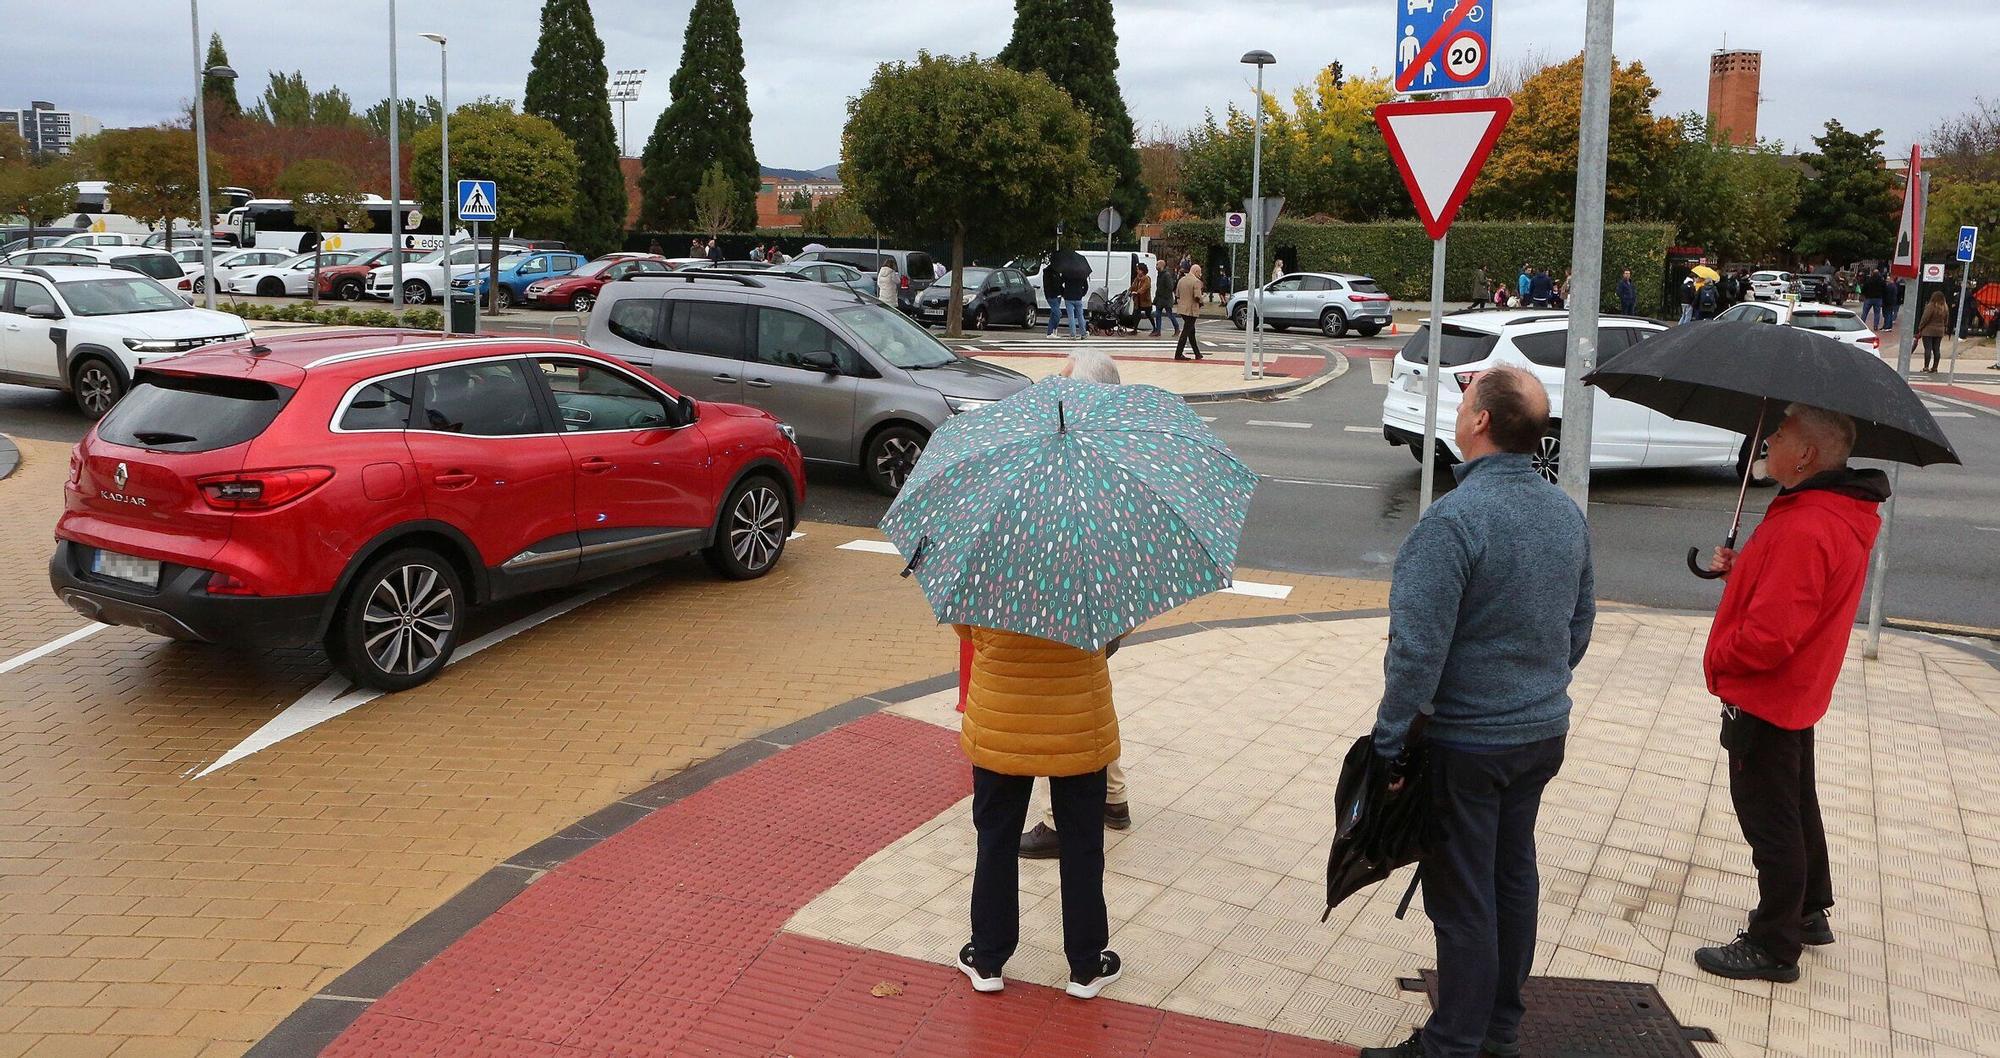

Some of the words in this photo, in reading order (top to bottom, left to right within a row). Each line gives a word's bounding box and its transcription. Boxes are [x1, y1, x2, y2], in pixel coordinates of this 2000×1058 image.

[1452, 47, 1477, 65] 20
[421, 235, 444, 248] edsa
[100, 490, 147, 507] KADJAR
